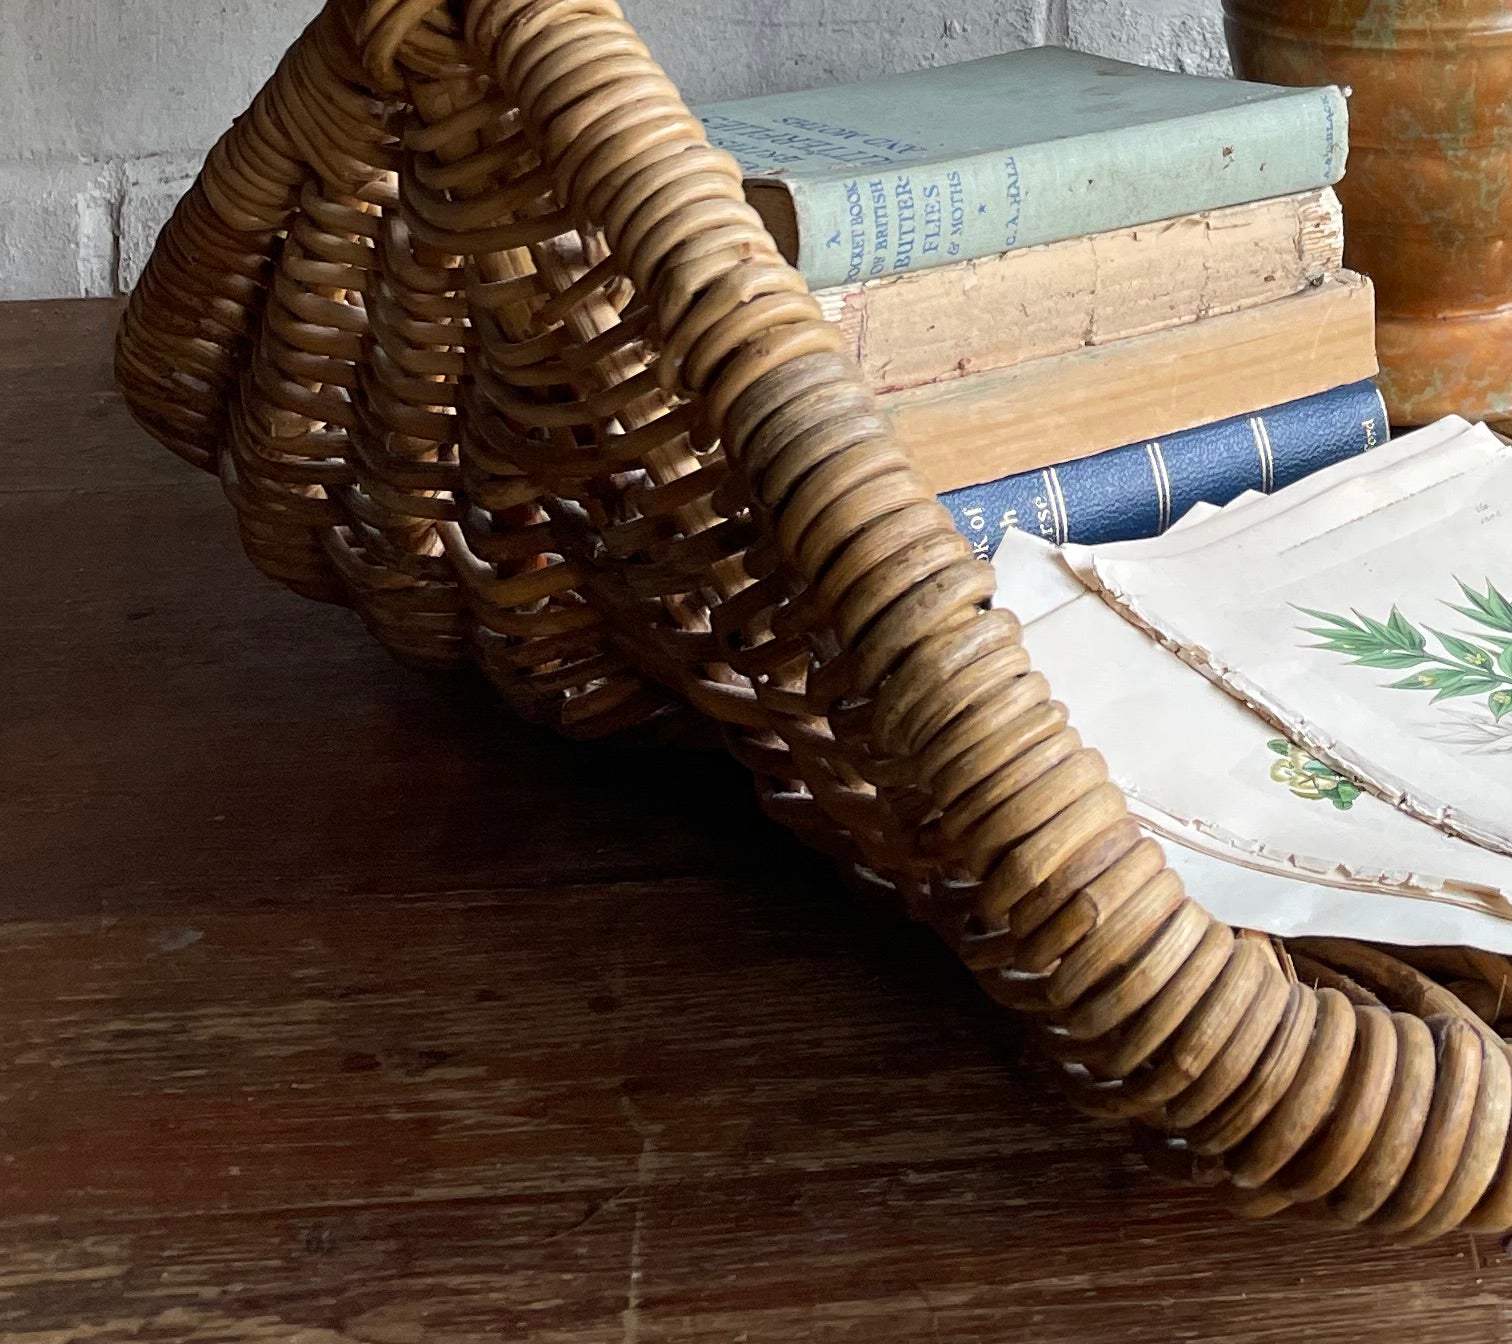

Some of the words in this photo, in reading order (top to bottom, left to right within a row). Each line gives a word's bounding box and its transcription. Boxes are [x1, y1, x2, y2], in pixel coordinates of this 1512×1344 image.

[701, 116, 896, 166] BUTTERFLIES
[712, 138, 804, 164] BRITIS
[862, 137, 928, 154] AND
[843, 179, 865, 226] BOOK
[869, 178, 889, 251] BRITISH
[893, 175, 917, 270] BUTTER-
[921, 184, 943, 254] FLIES
[946, 169, 965, 236] MOTHS
[826, 231, 841, 249] A
[945, 241, 961, 257] &
